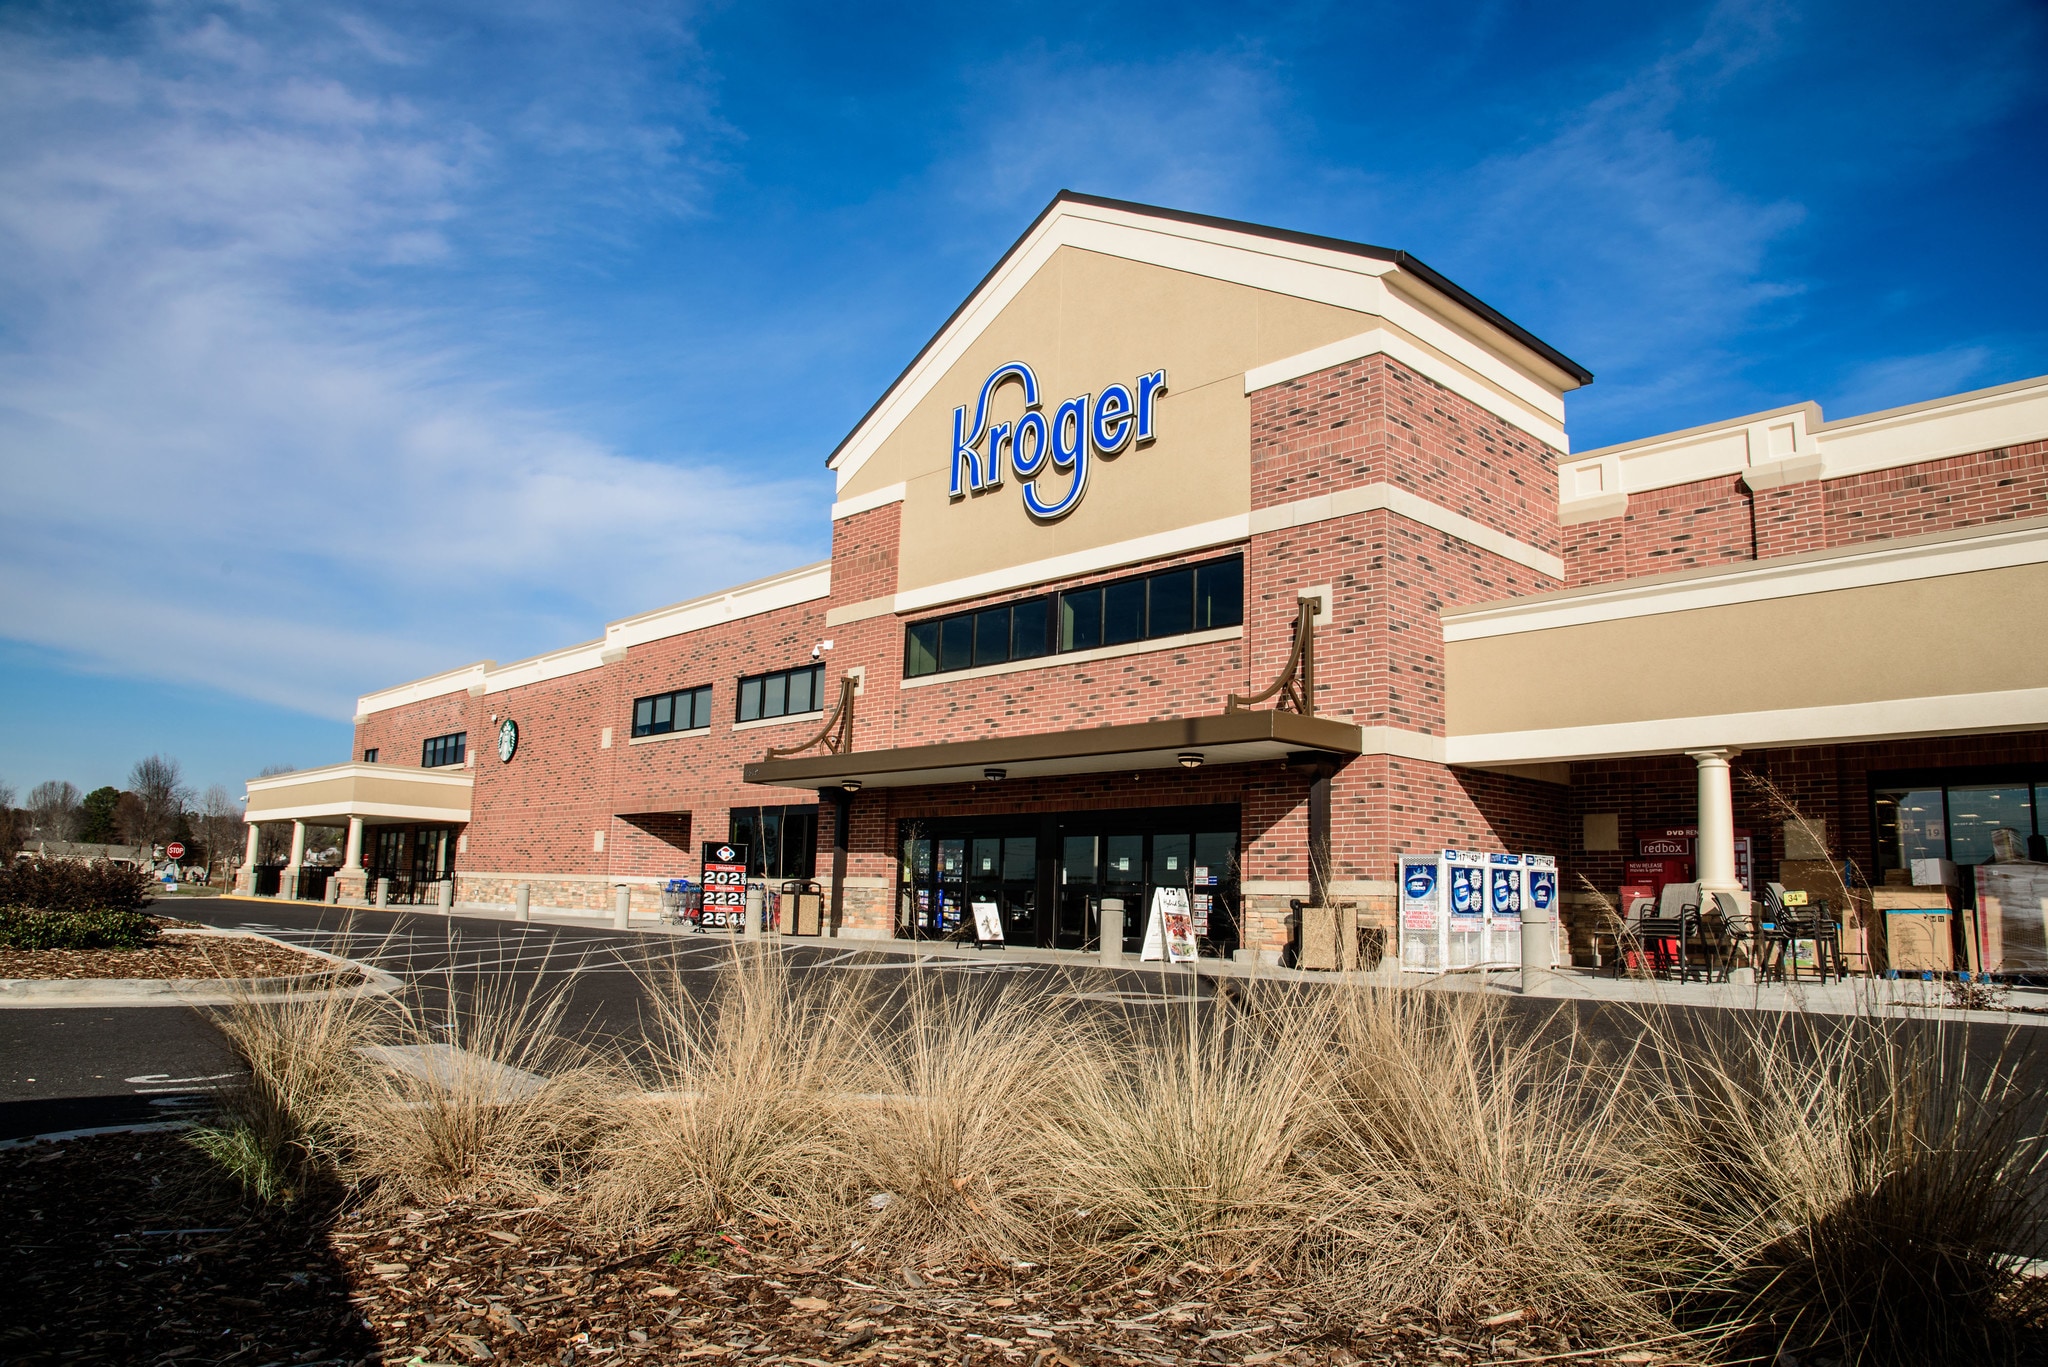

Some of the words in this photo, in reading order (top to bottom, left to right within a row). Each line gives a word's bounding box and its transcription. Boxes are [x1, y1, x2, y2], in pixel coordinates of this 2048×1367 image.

[949, 361, 1168, 519] Kroger
[1928, 829, 1940, 837] 19
[1644, 843, 1682, 853] redbox
[703, 872, 740, 884] 202
[703, 892, 739, 905] 222
[1788, 894, 1798, 902] 34
[702, 912, 739, 925] 254
